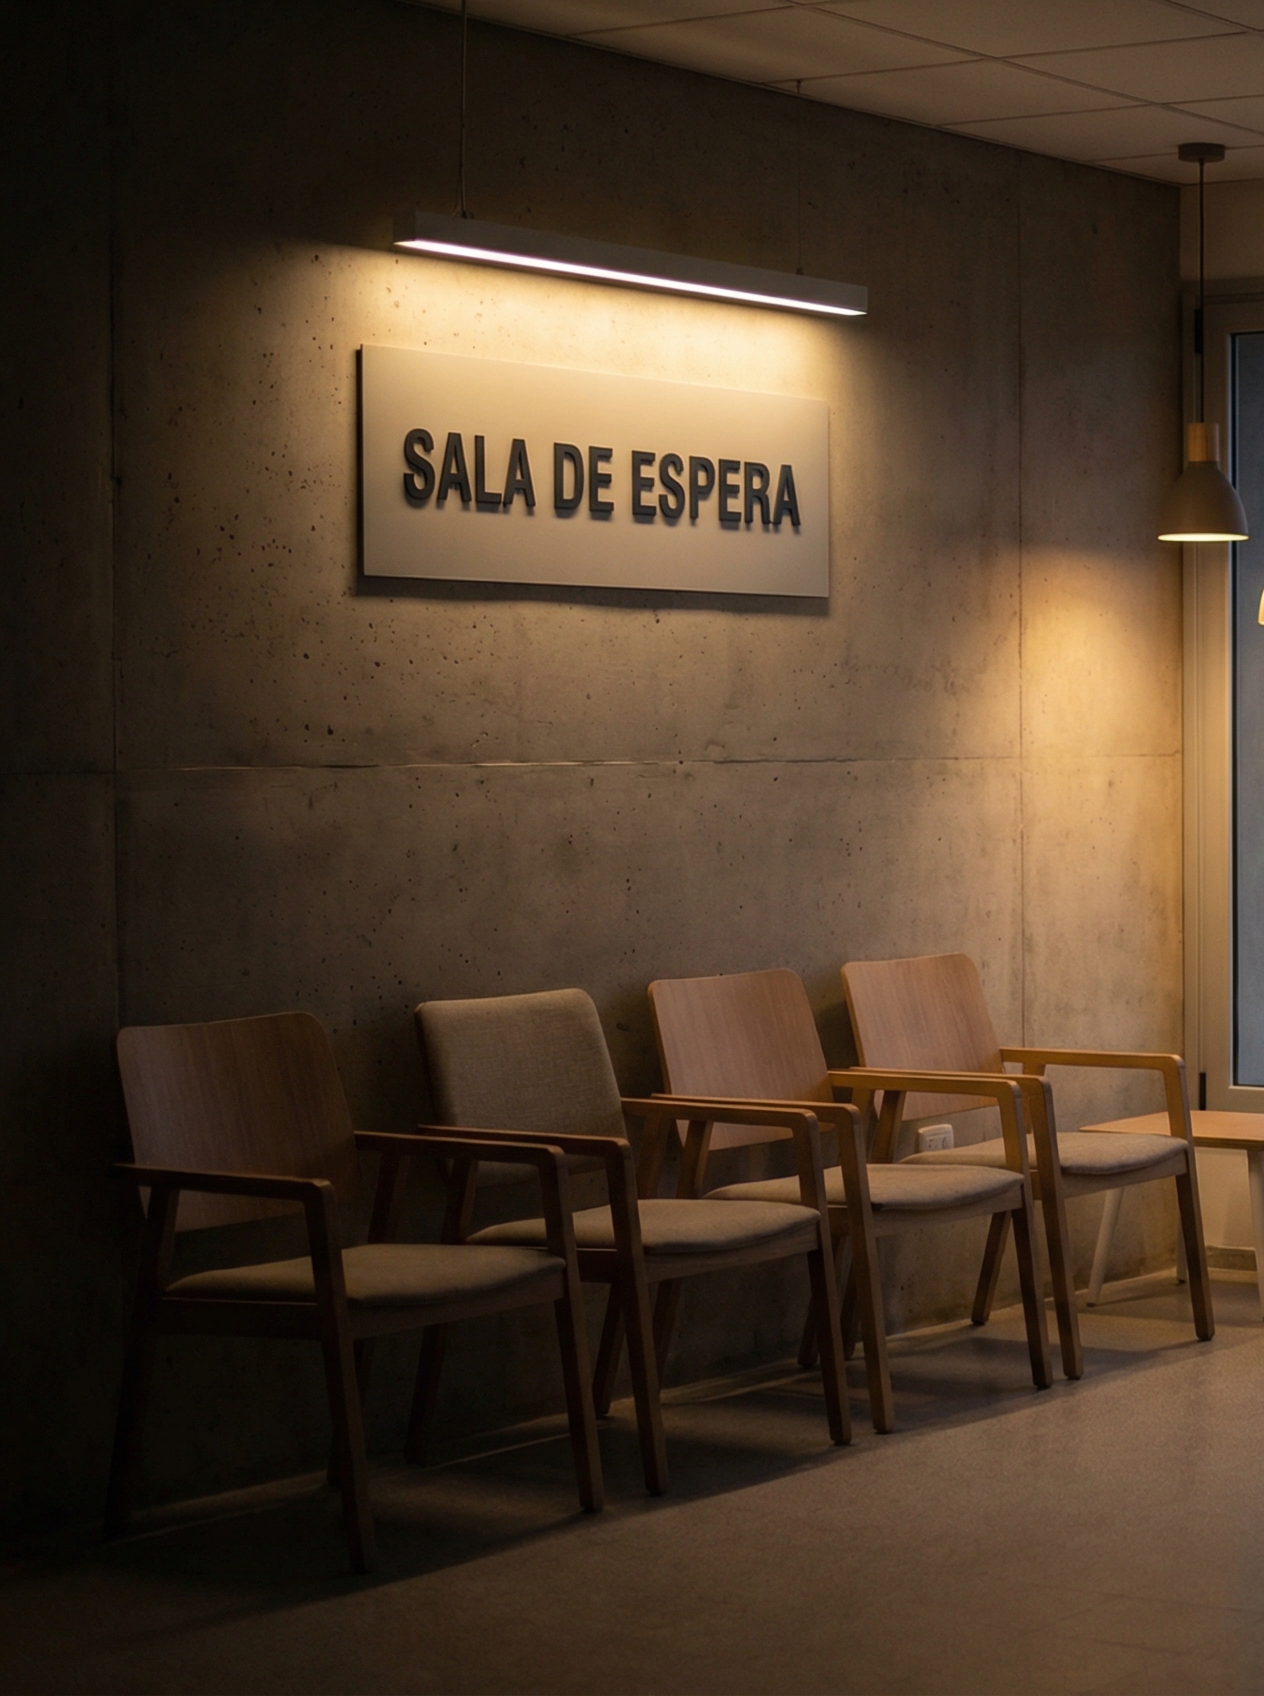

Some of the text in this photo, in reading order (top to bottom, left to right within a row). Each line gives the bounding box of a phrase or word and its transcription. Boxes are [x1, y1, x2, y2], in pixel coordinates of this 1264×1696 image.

[403, 428, 801, 526] SALA DE ESPERA
